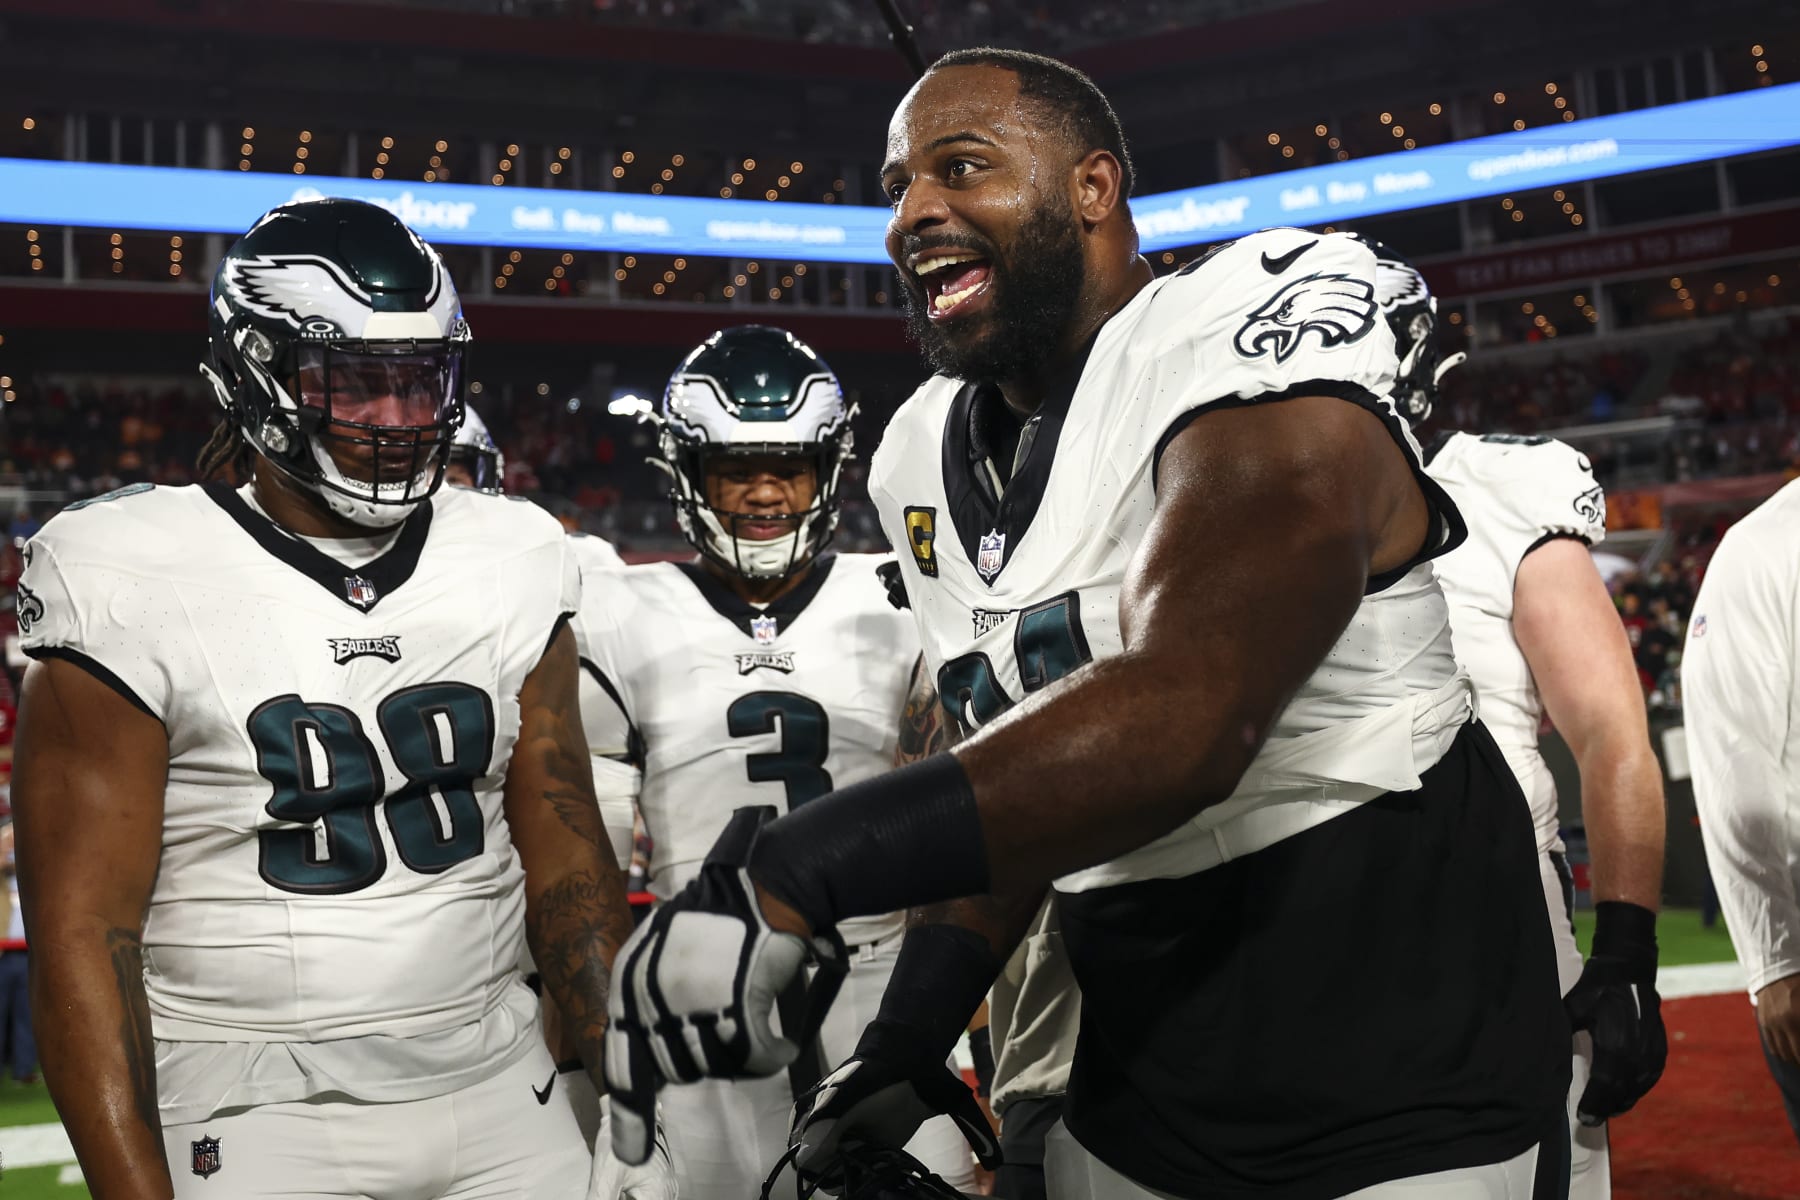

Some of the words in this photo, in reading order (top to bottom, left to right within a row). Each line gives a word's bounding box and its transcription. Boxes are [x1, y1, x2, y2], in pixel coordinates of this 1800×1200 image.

[301, 331, 343, 339] OAKLEY
[906, 511, 932, 560] C
[326, 635, 402, 665] EAGLES
[734, 651, 795, 676] EAGLES
[727, 691, 833, 812] 3
[246, 680, 495, 895] 98
